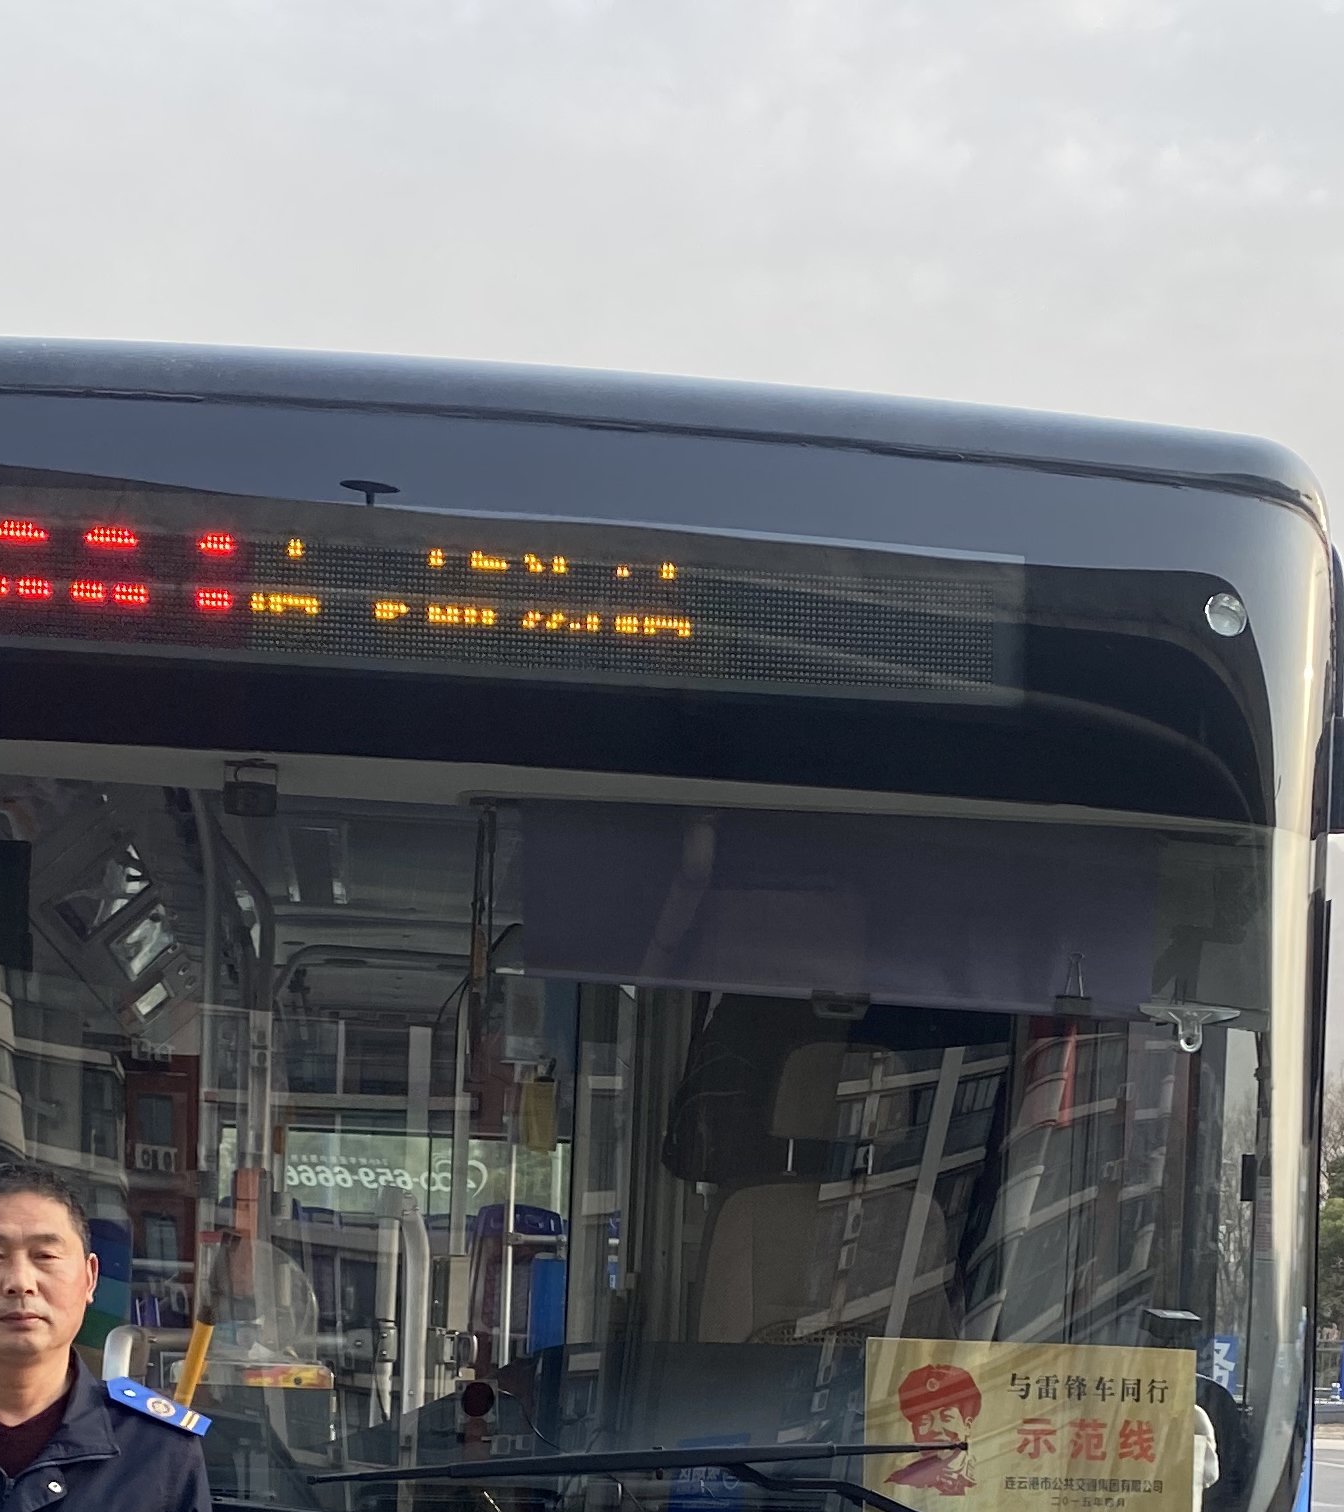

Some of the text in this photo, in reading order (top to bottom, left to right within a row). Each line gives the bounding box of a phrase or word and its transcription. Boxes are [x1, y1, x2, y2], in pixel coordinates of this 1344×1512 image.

[1007, 1373, 1169, 1404] 与雷锋车同行
[1017, 1418, 1155, 1463] 示范线
